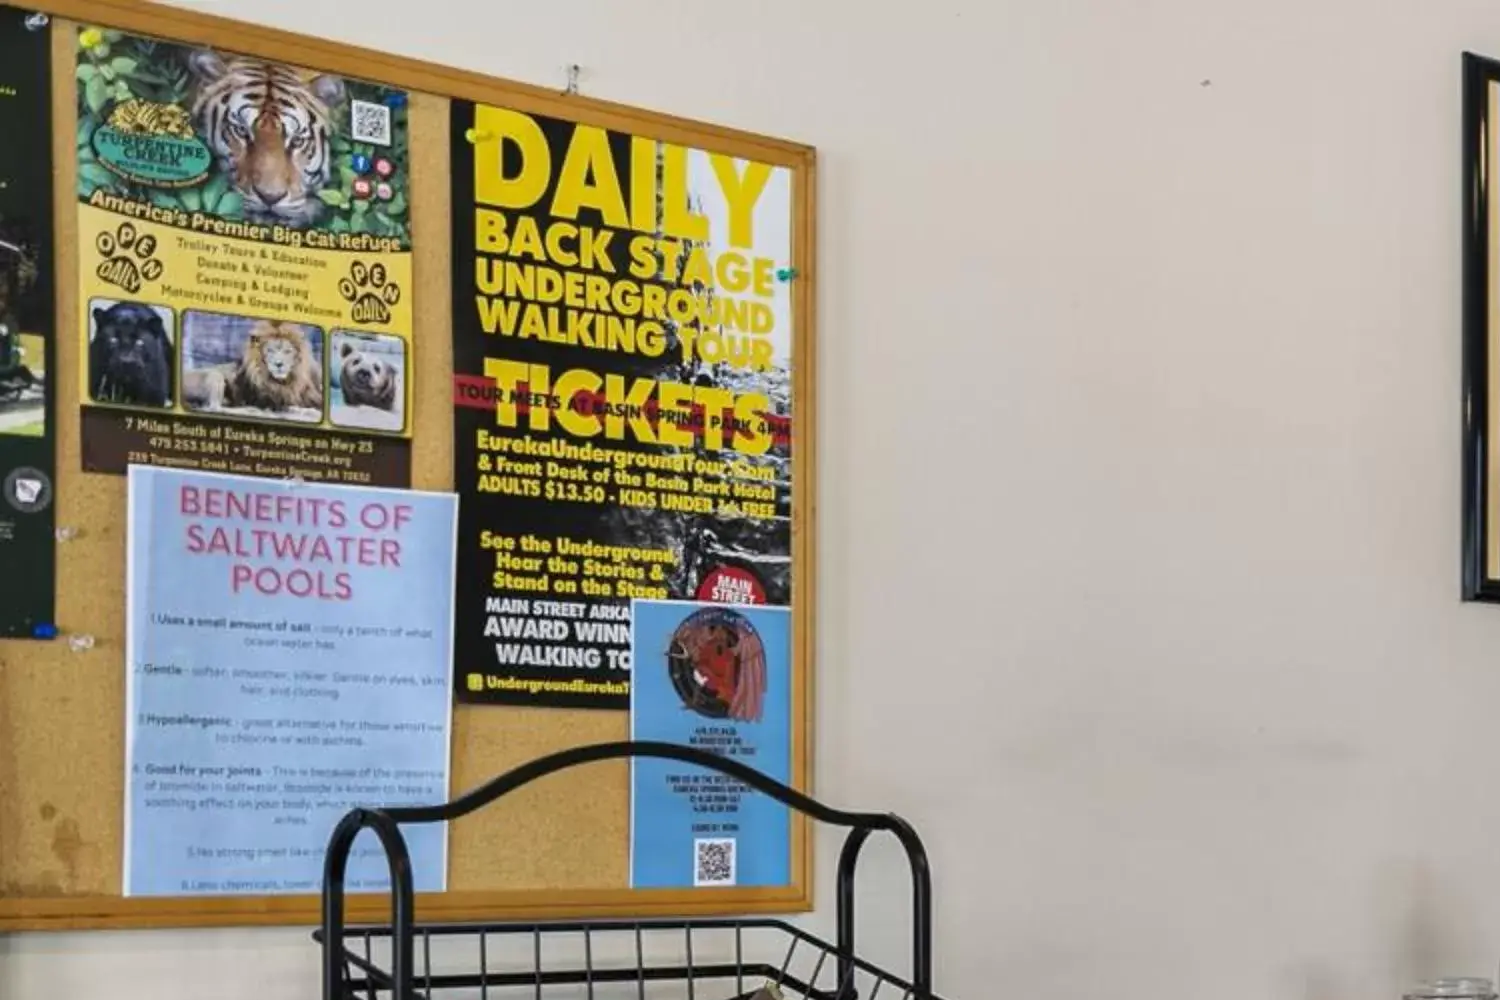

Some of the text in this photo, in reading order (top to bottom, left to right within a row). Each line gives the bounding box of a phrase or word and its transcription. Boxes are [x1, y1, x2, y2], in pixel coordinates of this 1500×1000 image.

[99, 131, 206, 160] TURPENTINE
[123, 146, 182, 168] CREEK
[474, 102, 774, 249] DAILY
[90, 188, 401, 252] America's Premier Big Cat Refuge
[98, 223, 161, 279] OPEN
[176, 236, 328, 268] Trolley Tours & Education
[197, 256, 310, 281] Donate & Volunteer
[474, 207, 776, 297] BACK STAGE
[99, 259, 141, 292] DAILY
[196, 272, 310, 300] Camping & Lodging
[338, 260, 402, 305] OPEN
[161, 284, 342, 318] Motorcycles & Groups Welcome
[352, 298, 391, 322] DAILY
[474, 257, 776, 335] UNDERGROUND
[474, 295, 776, 374] WALKING TOUR
[458, 383, 504, 402] TOUR
[510, 390, 561, 409] MEETS
[710, 414, 752, 433] PARK
[483, 356, 773, 457] TICKETS
[125, 417, 134, 430] 7
[137, 418, 171, 434] Miles
[172, 421, 207, 437] South
[209, 427, 222, 439] of
[224, 428, 265, 443] Eureka
[267, 432, 313, 448] Springs
[315, 439, 329, 449] on
[331, 439, 356, 454] Hwy
[242, 445, 352, 468] TurpentineCreek.org
[477, 454, 776, 501] & Front Desk of the Basin Park Hotel
[180, 484, 413, 532] BENEFITS OF
[477, 474, 777, 519] ADULTS $13.50 KIDS UNDER FREE
[186, 523, 402, 568] SALTWATER
[479, 530, 680, 568] See the Underground,
[230, 563, 353, 601] POOLS
[496, 551, 664, 582] Hear the Stories &
[717, 574, 753, 591] MAIN
[492, 571, 669, 600] Stand on the Stage
[711, 587, 756, 604] STREET
[485, 596, 530, 615] MAIN
[532, 600, 587, 618] STREET
[483, 615, 569, 641] AWARD
[495, 643, 602, 669] WALKING
